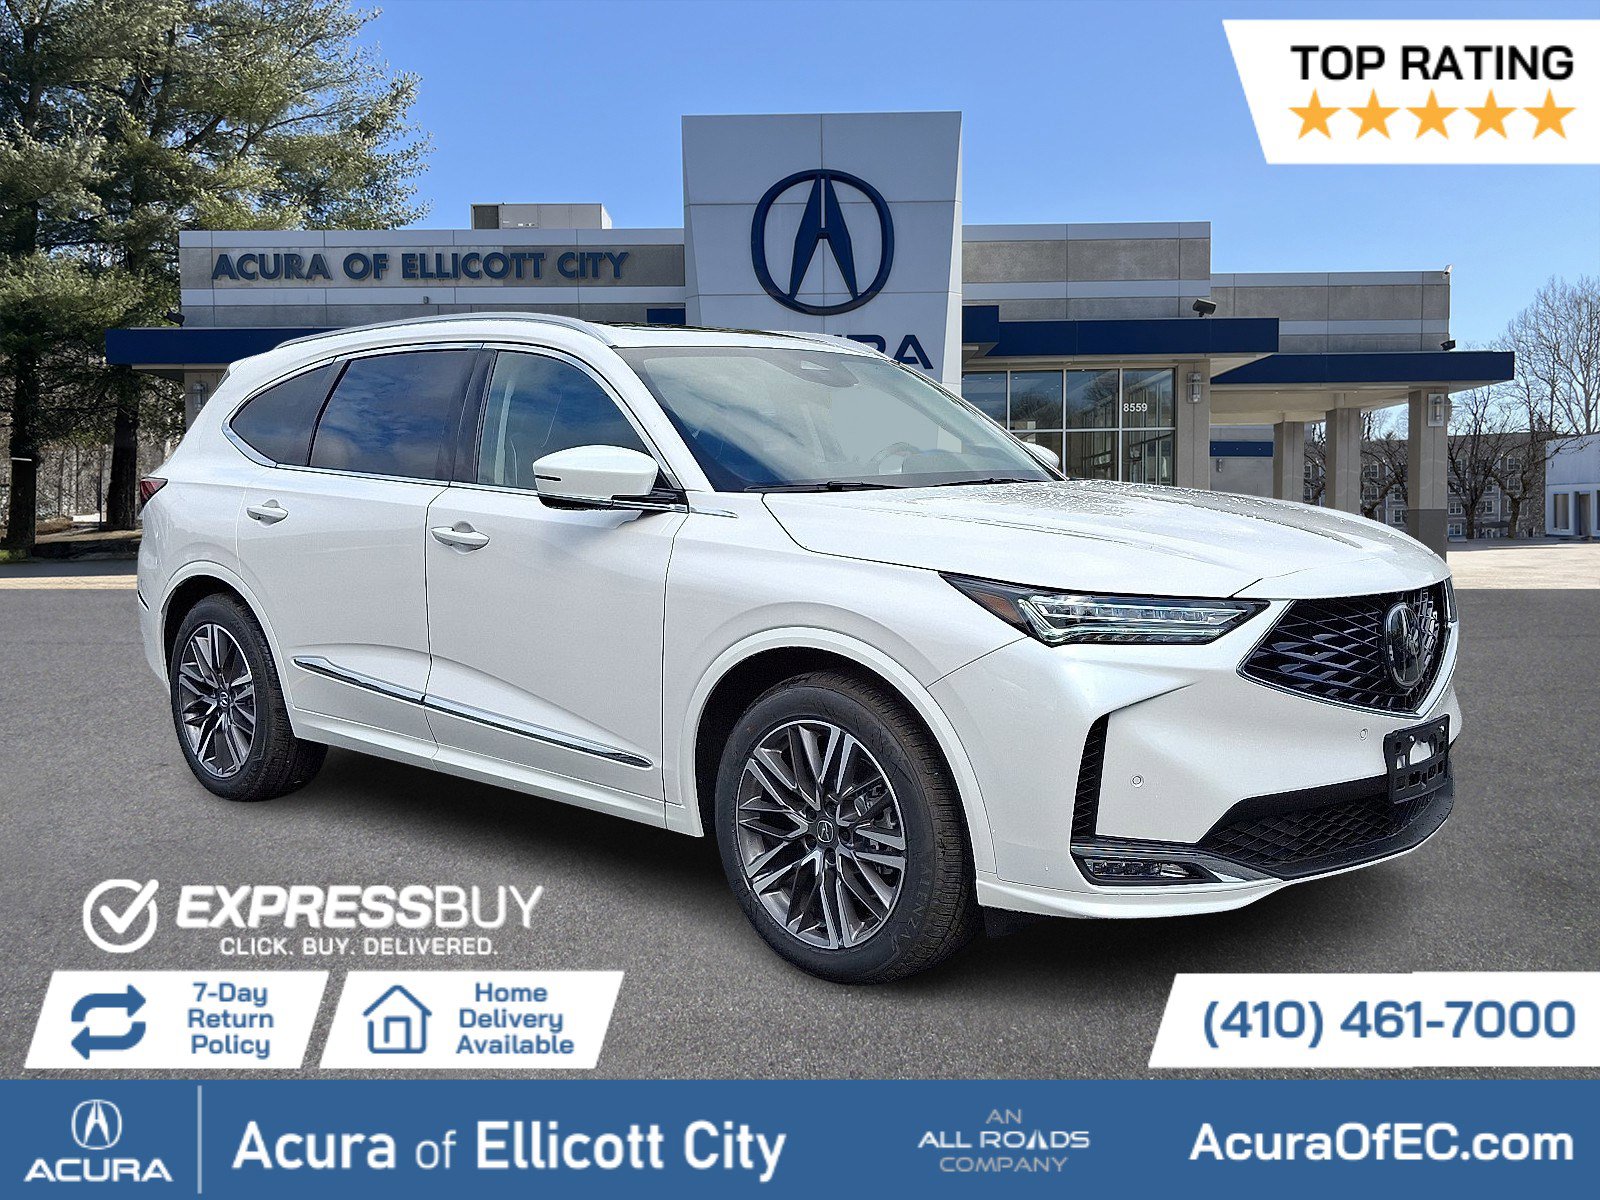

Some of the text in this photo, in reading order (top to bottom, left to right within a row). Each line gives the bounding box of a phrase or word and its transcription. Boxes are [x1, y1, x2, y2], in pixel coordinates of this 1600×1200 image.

[211, 251, 629, 281] ACURA OF ELLICOTT CITY
[1123, 402, 1148, 412] 8559
